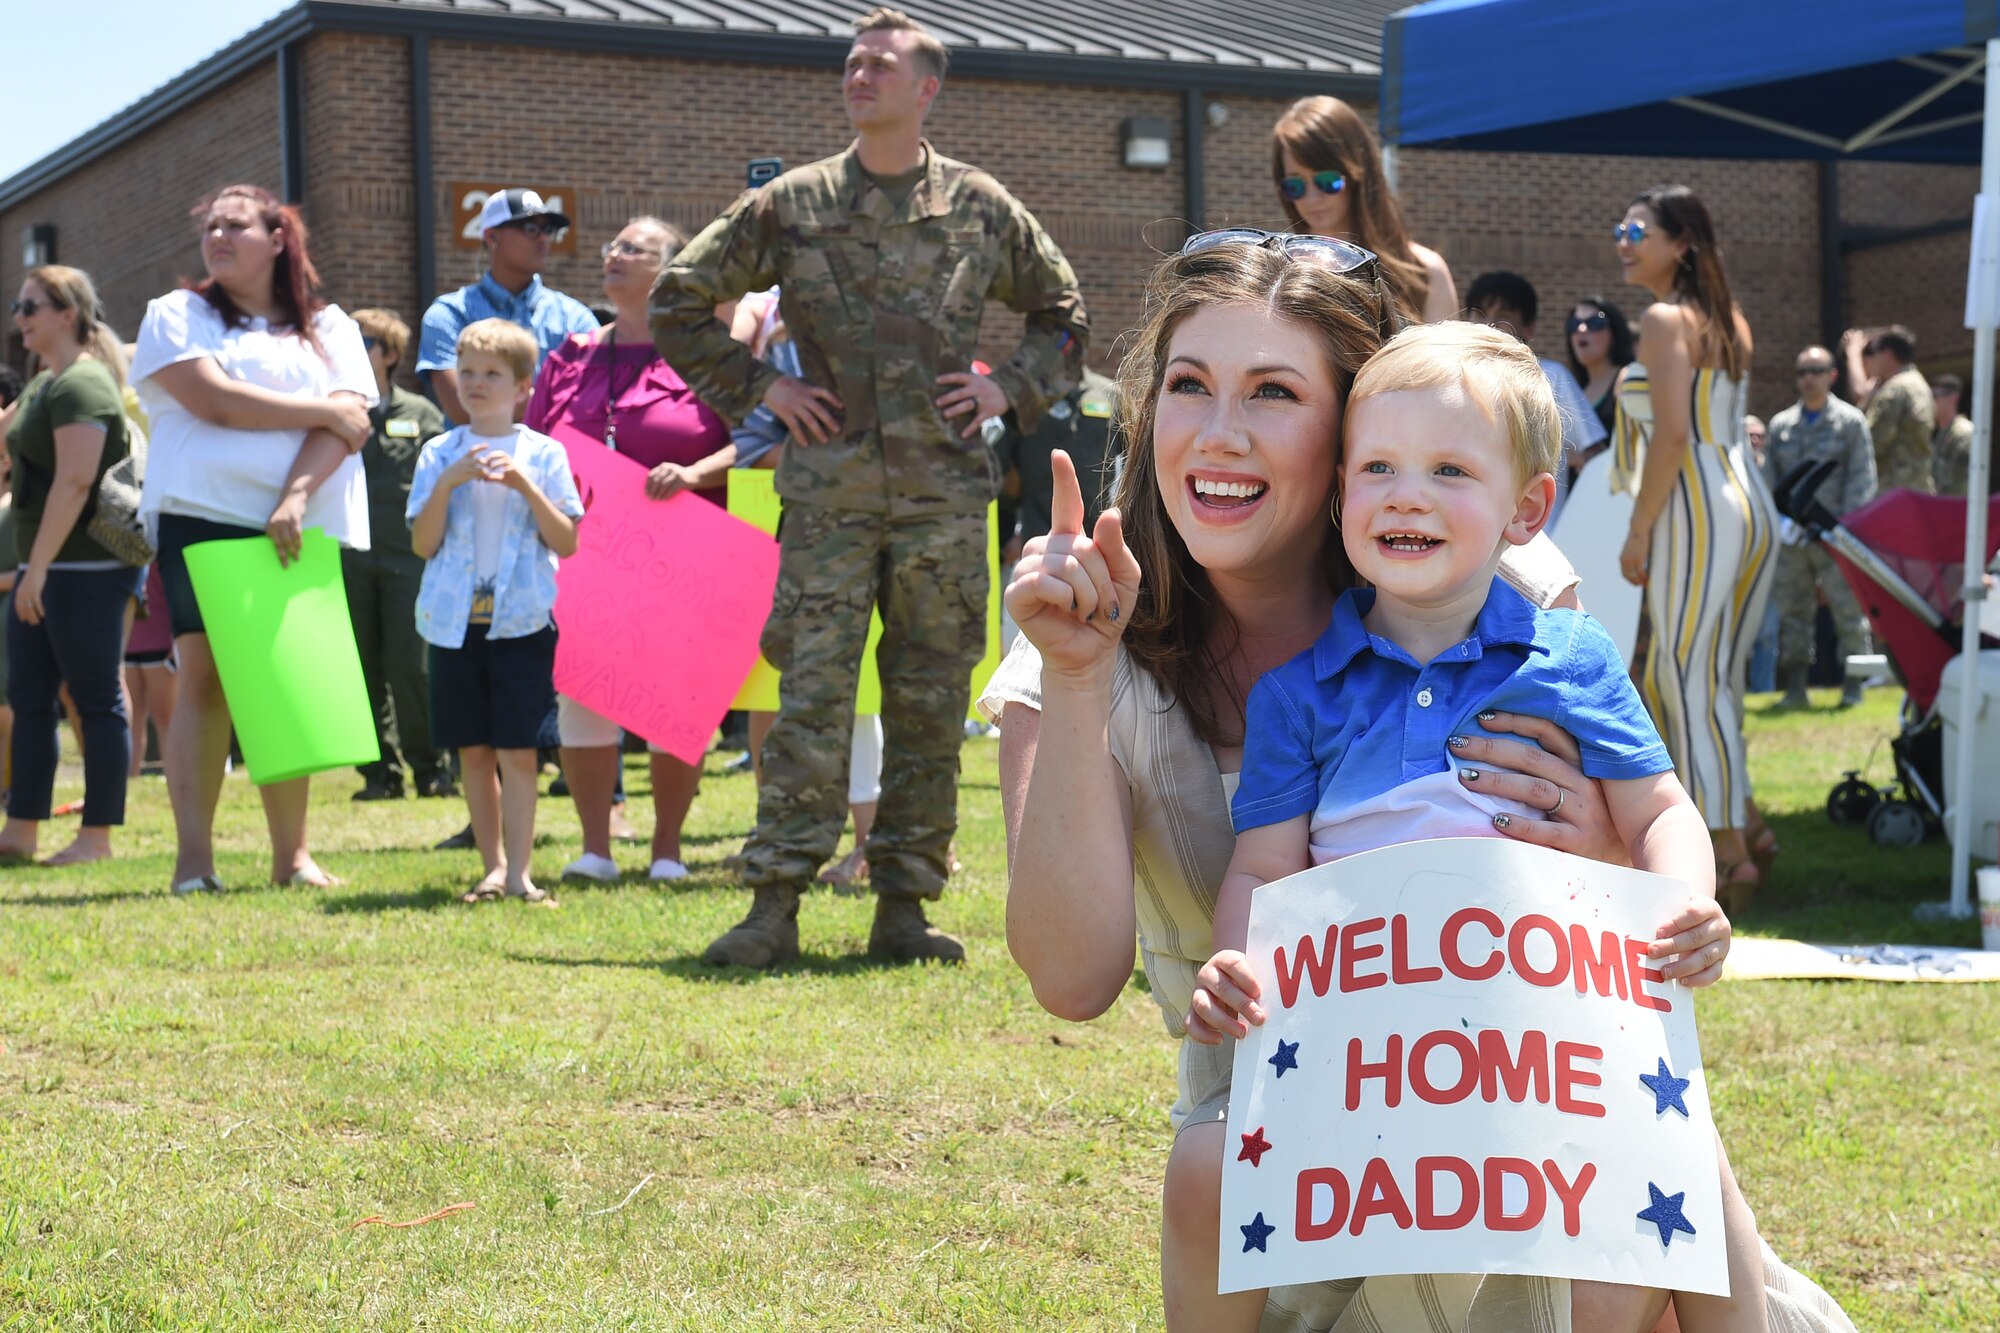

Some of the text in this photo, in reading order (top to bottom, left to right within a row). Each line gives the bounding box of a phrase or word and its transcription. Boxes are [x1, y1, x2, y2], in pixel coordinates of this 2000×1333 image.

[461, 190, 568, 243] 24
[1273, 907, 1672, 1013] WELCOME
[1344, 1029, 1606, 1118] HOME
[1295, 1156, 1597, 1242] DADDY
